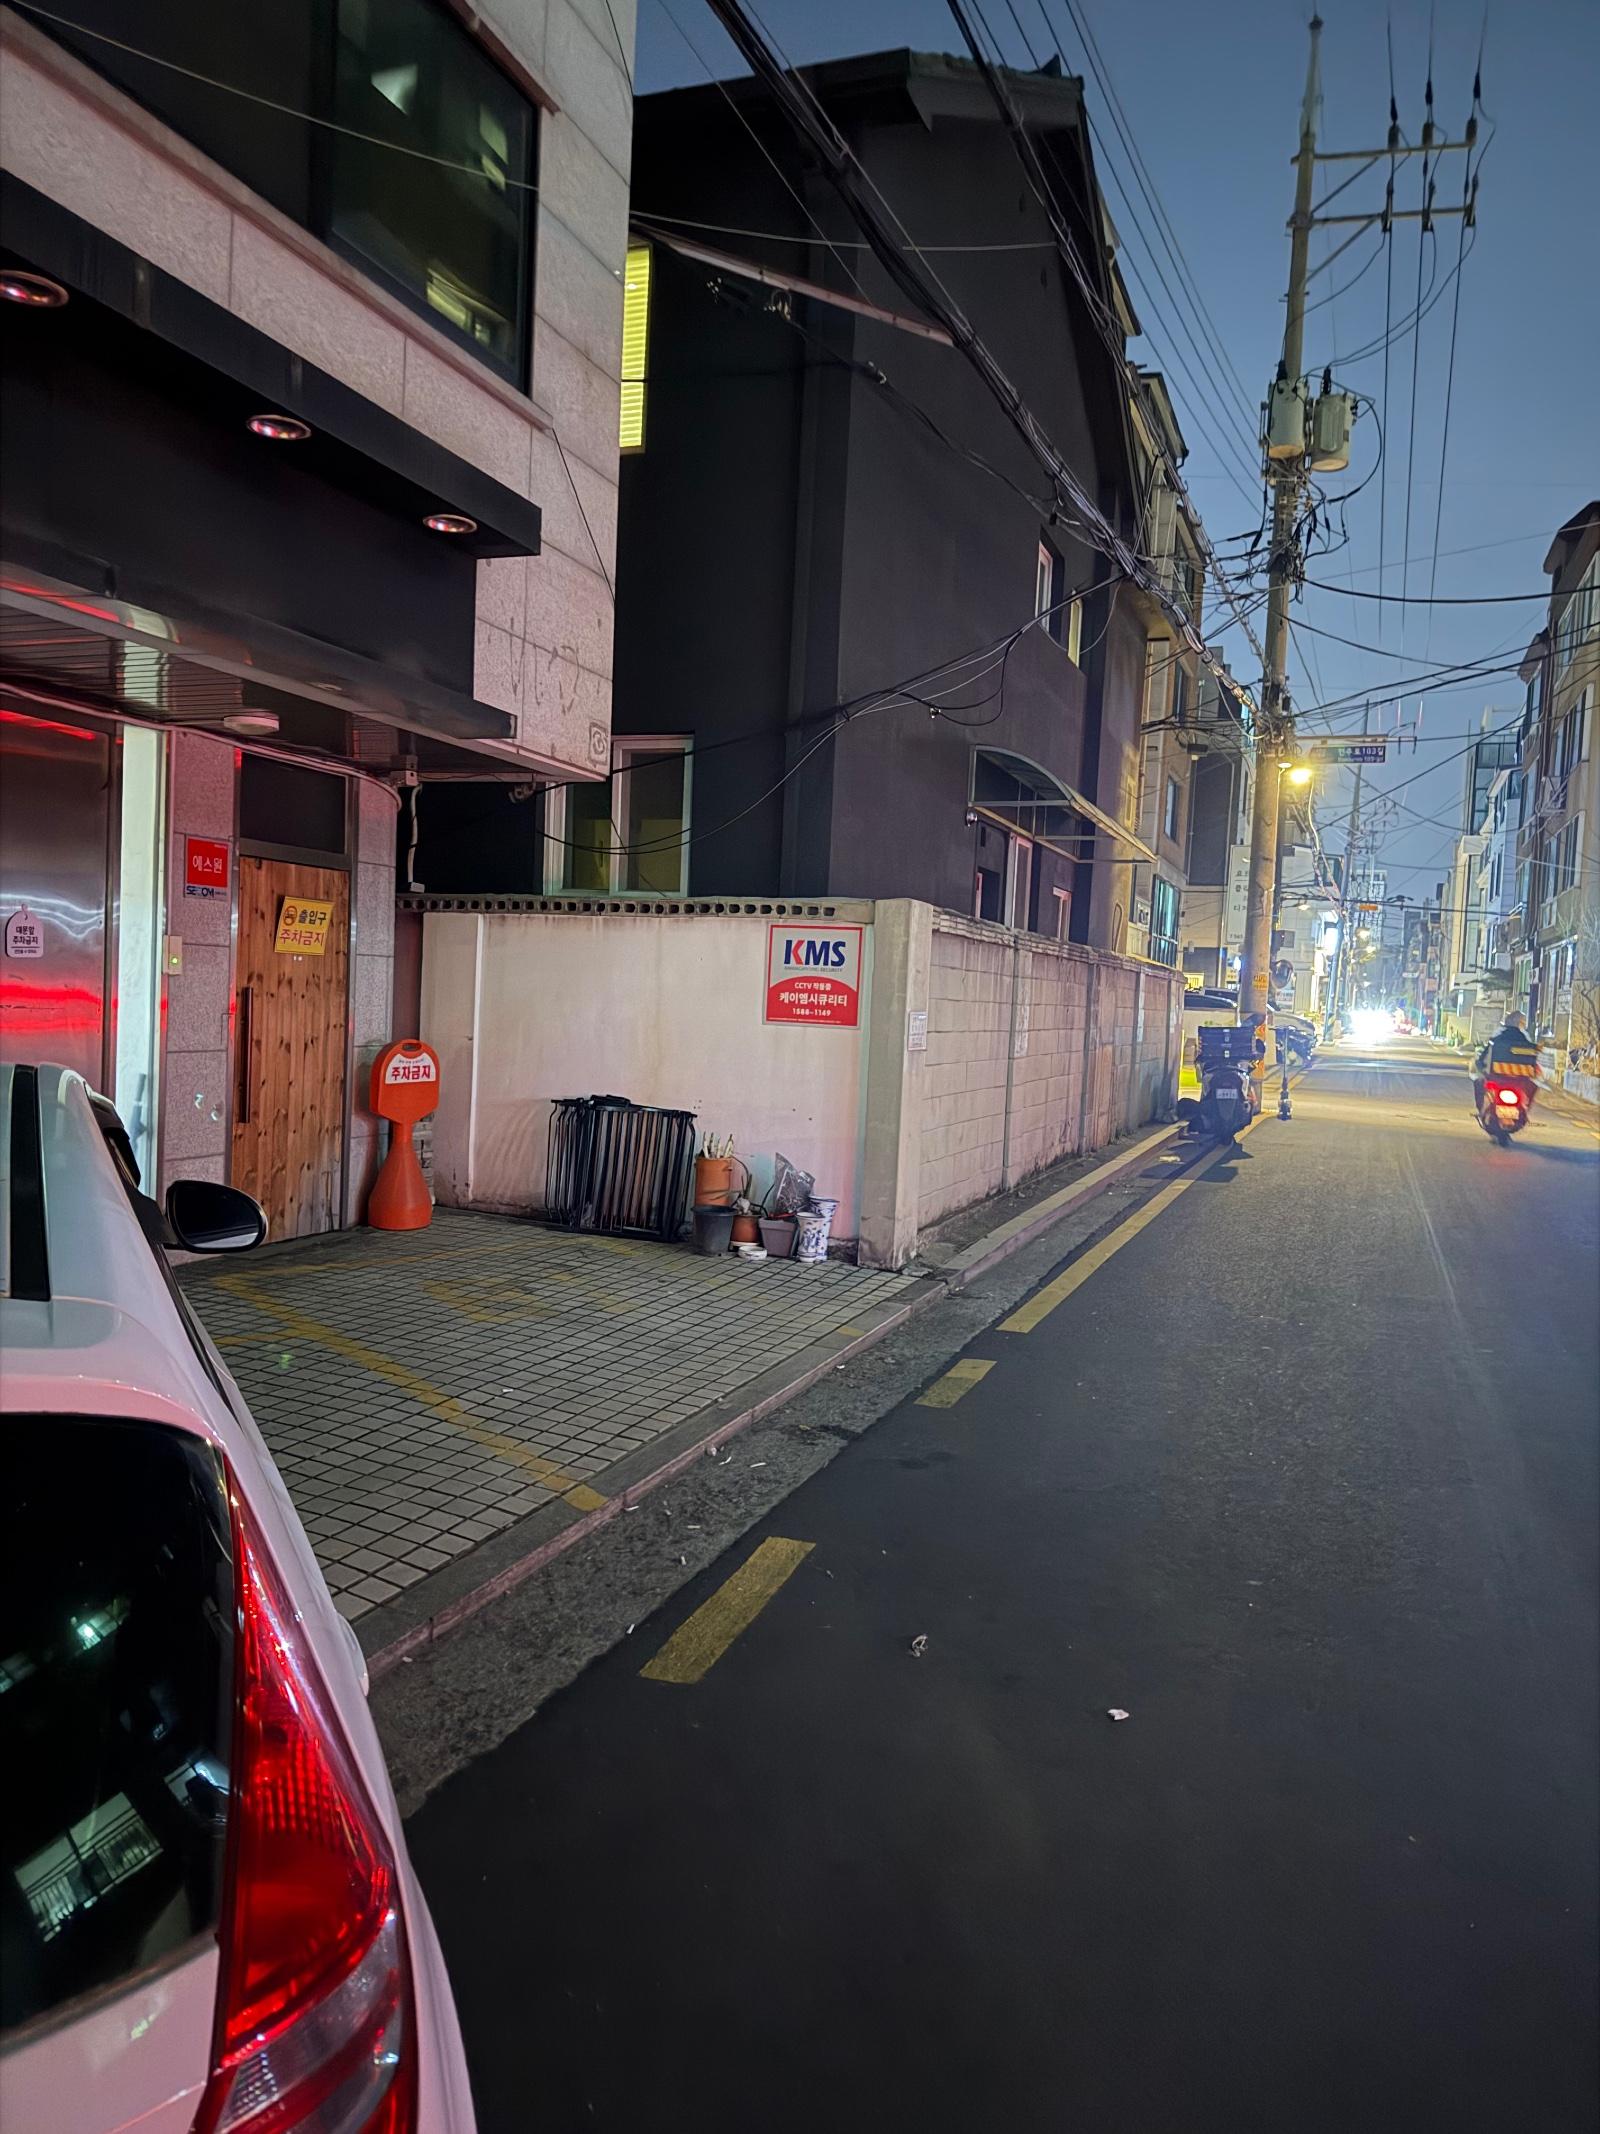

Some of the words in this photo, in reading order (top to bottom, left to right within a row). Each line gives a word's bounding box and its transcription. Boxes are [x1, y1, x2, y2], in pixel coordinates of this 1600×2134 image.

[192, 855, 223, 873] 에스원
[298, 908, 327, 926] 출입구
[15, 925, 35, 935] 대문앞
[279, 928, 324, 946] 주차금지
[13, 935, 39, 945] 주차금지
[784, 939, 846, 967] KMS
[794, 982, 812, 990] CCTV
[779, 991, 848, 1007] 케이엠시큐리티
[792, 1007, 832, 1017] 1588-1149
[391, 1064, 431, 1081] 주차금지
